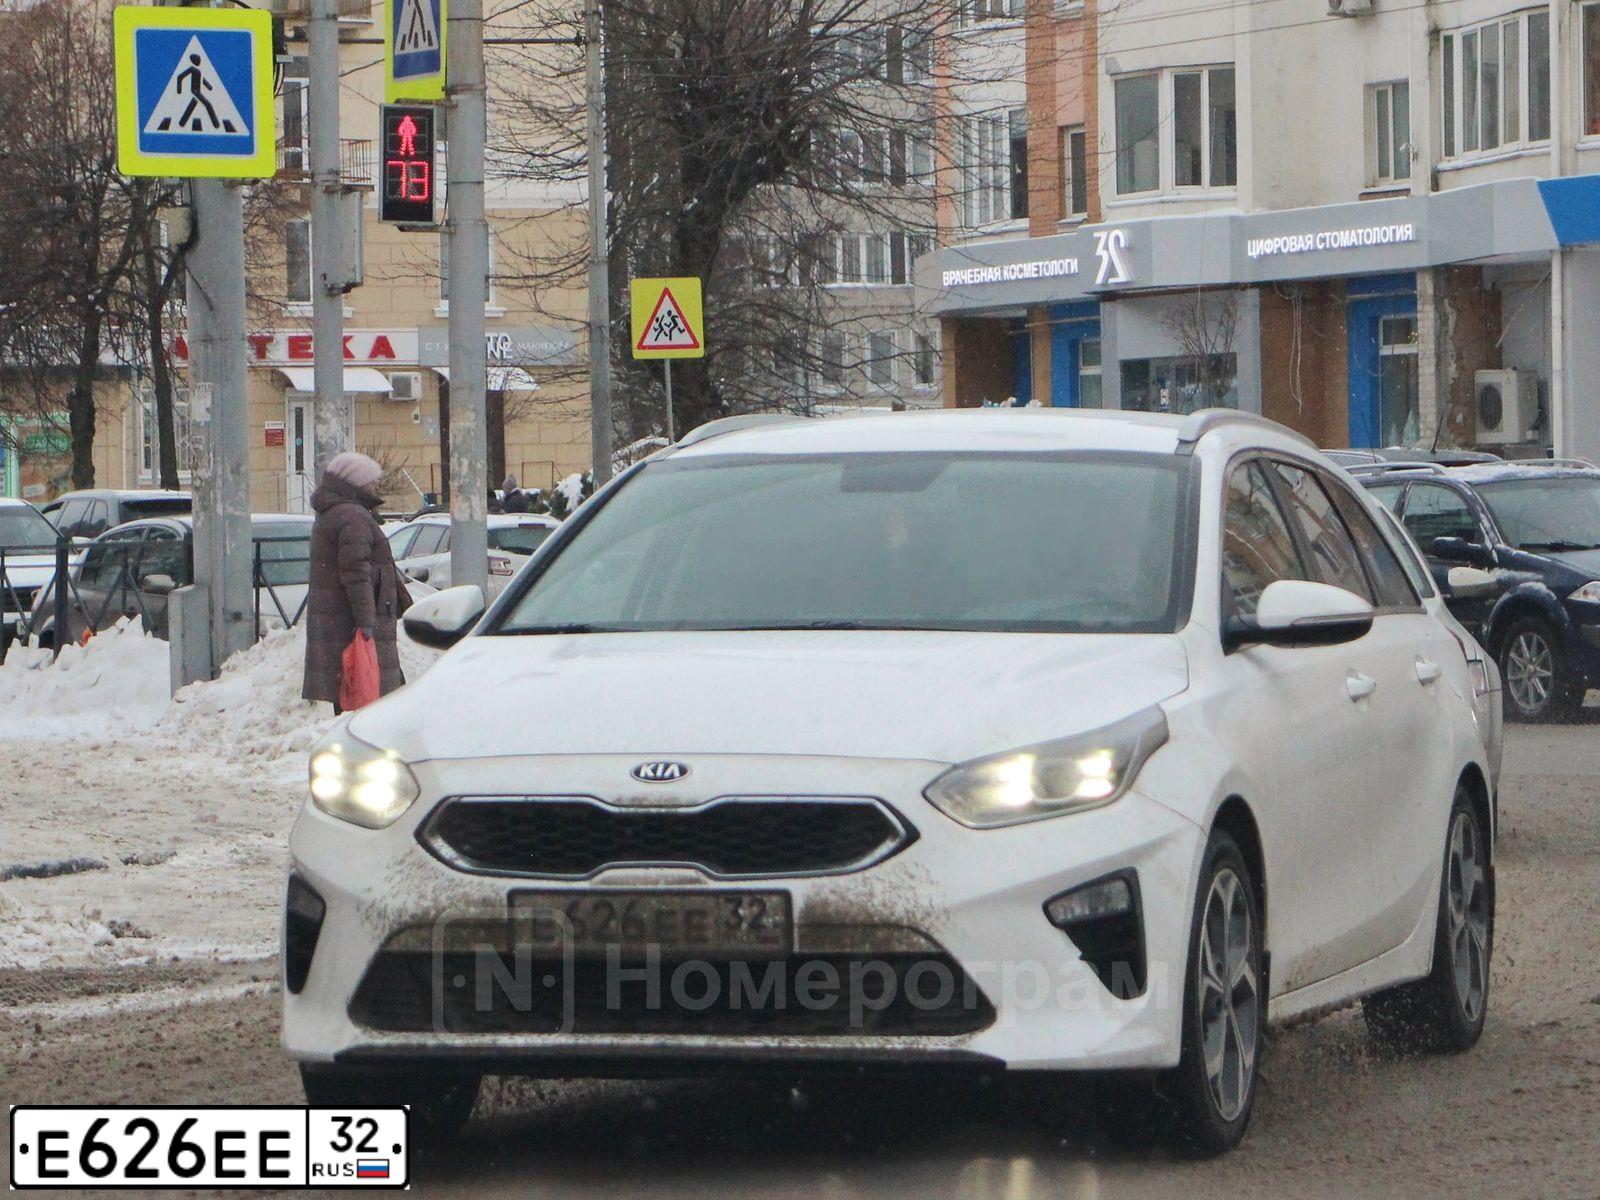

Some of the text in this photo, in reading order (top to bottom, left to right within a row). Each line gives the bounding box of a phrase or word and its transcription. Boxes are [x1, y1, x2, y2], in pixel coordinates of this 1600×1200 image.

[387, 160, 428, 200] 73
[1247, 223, 1413, 259] ЦИФРОВАЯ СТОМАТОЛОГИЯ
[942, 257, 1079, 287] ВРАЧЕБНАЯ КОСМЕТОЛОГИ
[164, 334, 396, 360] АТЕА
[639, 763, 680, 778] KIA
[723, 896, 768, 930] 32
